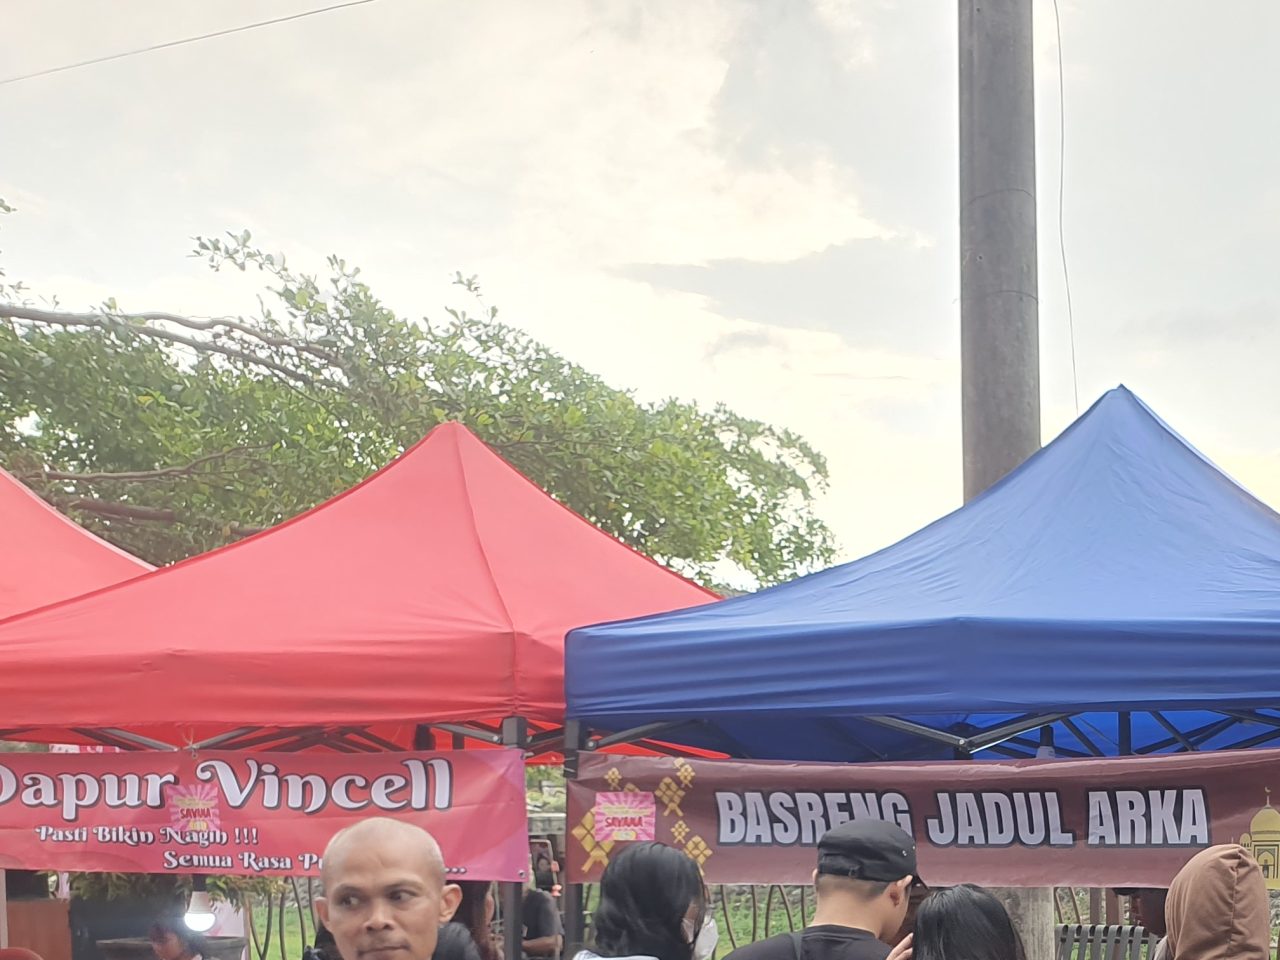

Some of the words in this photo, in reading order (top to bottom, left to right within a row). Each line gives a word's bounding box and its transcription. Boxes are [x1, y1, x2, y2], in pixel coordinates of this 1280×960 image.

[195, 758, 451, 812] Vincell
[926, 792, 1073, 845] JADUL
[1088, 789, 1208, 844] ARKA
[35, 826, 88, 842] Pasti
[92, 826, 154, 845] Bikin
[234, 828, 258, 844] !!!
[164, 851, 232, 869] Semua
[238, 852, 292, 870] Rasa
